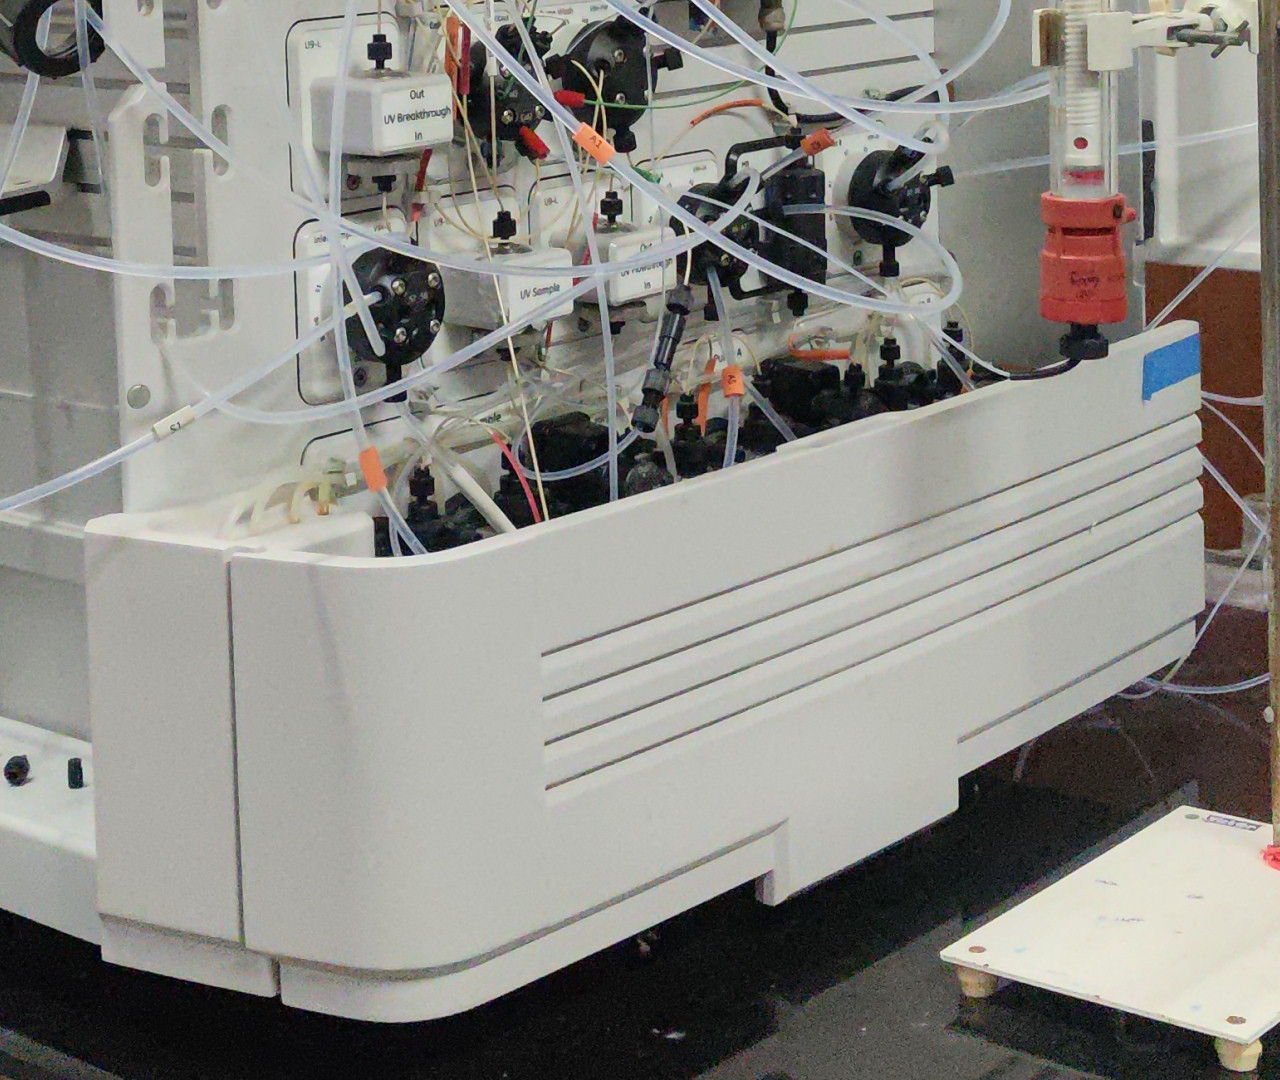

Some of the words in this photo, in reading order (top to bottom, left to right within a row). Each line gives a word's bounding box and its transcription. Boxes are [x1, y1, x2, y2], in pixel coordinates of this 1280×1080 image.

[409, 89, 425, 100] Out
[384, 113, 396, 125] UV
[397, 105, 452, 124] Breakthrough
[414, 131, 424, 141] In
[588, 133, 604, 149] A1
[520, 288, 531, 301] UV
[532, 282, 561, 298] Sample
[644, 281, 651, 290] In
